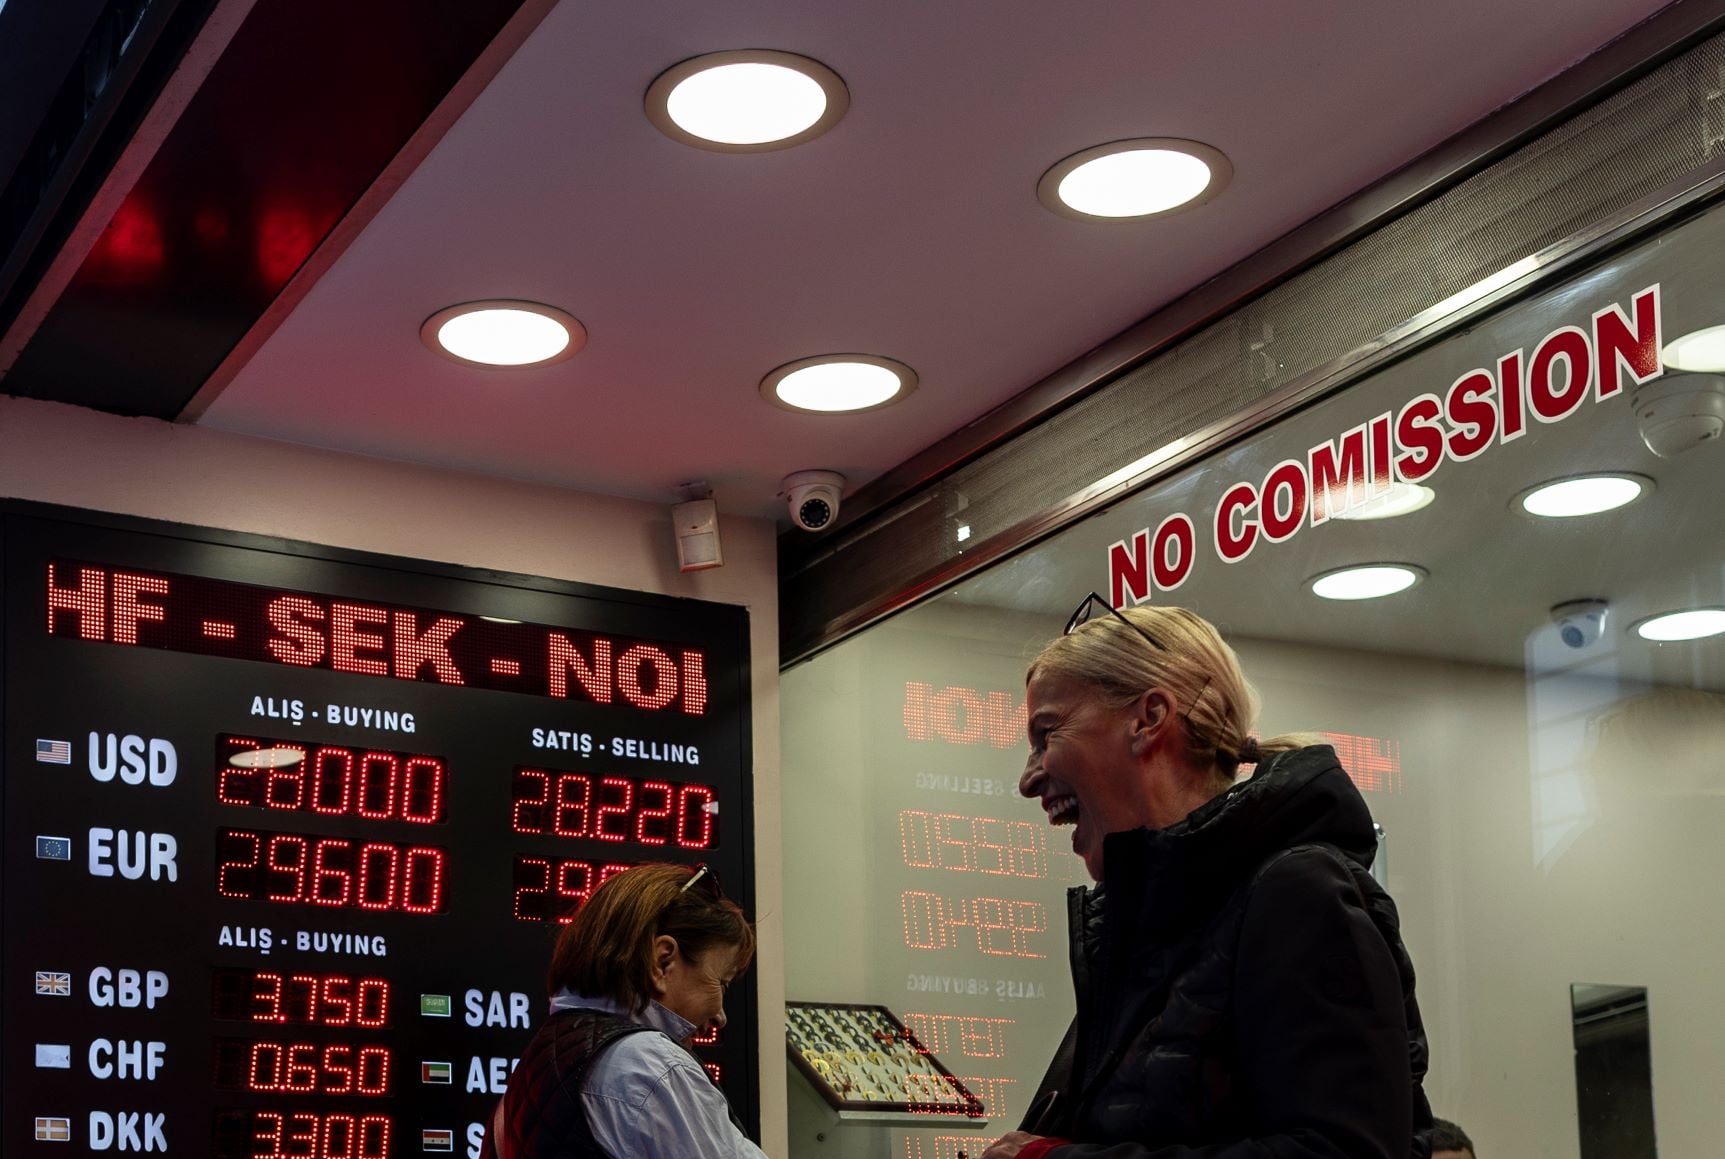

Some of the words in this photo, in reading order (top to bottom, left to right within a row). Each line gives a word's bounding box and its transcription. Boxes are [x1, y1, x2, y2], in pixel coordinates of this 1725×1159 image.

[1108, 513, 1196, 609] NO
[1214, 283, 1664, 563] COMISSION
[268, 596, 465, 685] SEK
[326, 704, 416, 733] BUYING
[88, 731, 178, 787] USD
[611, 737, 700, 765] SELLING
[88, 827, 178, 883] EUR
[296, 931, 387, 957] BUYING
[88, 966, 169, 1010] GBP
[253, 973, 389, 1027] 3.750
[464, 988, 530, 1029] SAR
[88, 1038, 166, 1081] CHF
[249, 1043, 389, 1095] 0.650
[465, 1055, 521, 1095] AE
[89, 1110, 168, 1153] DKK
